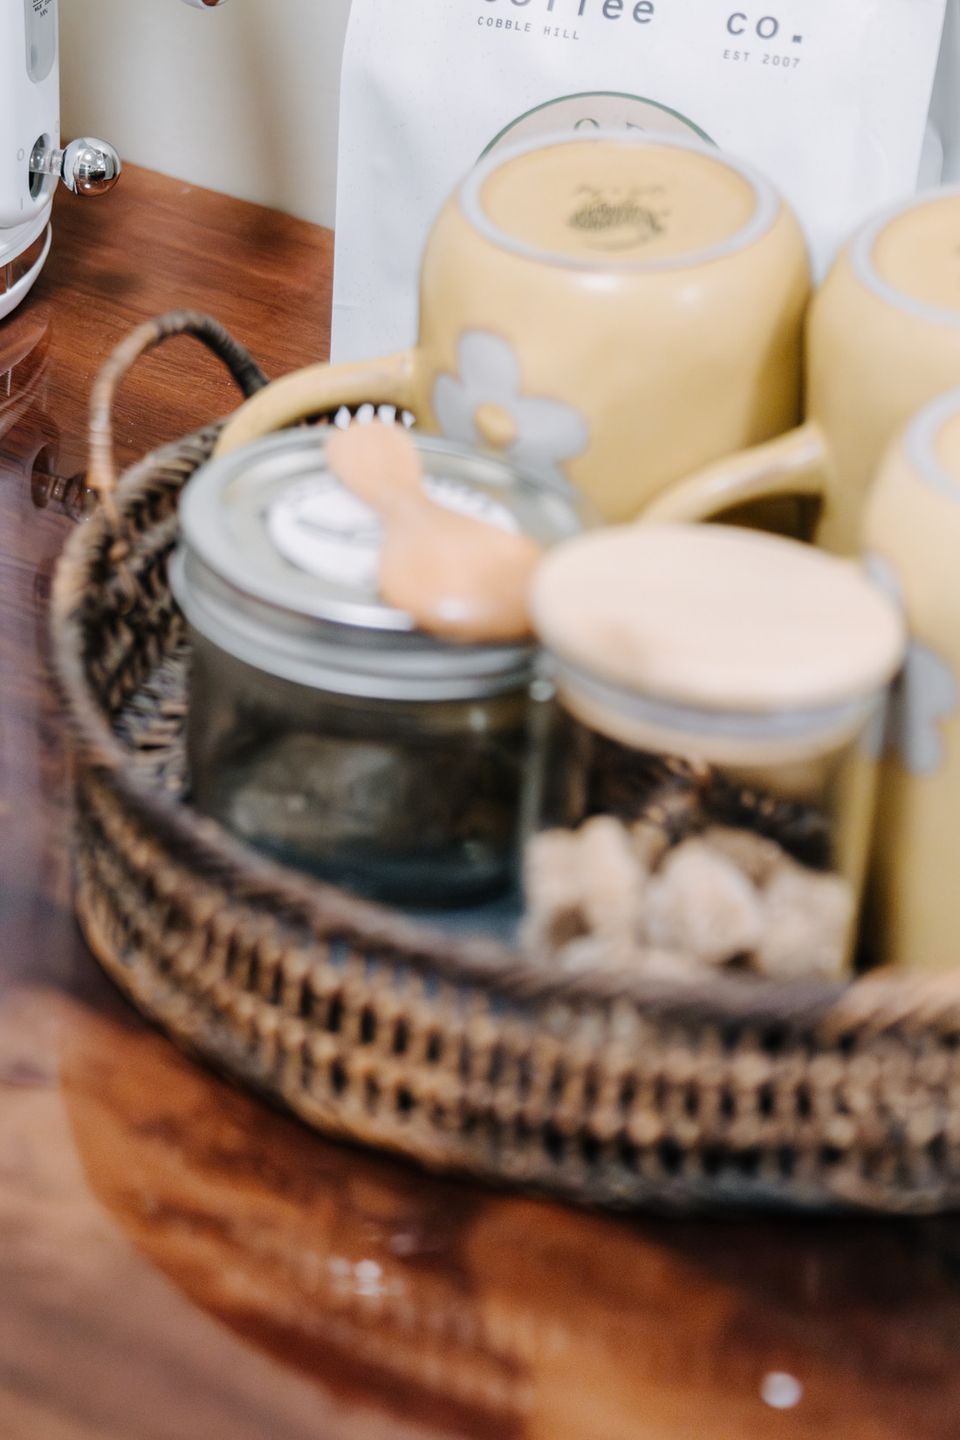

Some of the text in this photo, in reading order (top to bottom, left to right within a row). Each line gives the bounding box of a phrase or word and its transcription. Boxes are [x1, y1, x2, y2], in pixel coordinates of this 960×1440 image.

[477, 16, 580, 40] COBBLE HILL
[726, 11, 803, 44] co.
[722, 49, 801, 68] EST 2007
